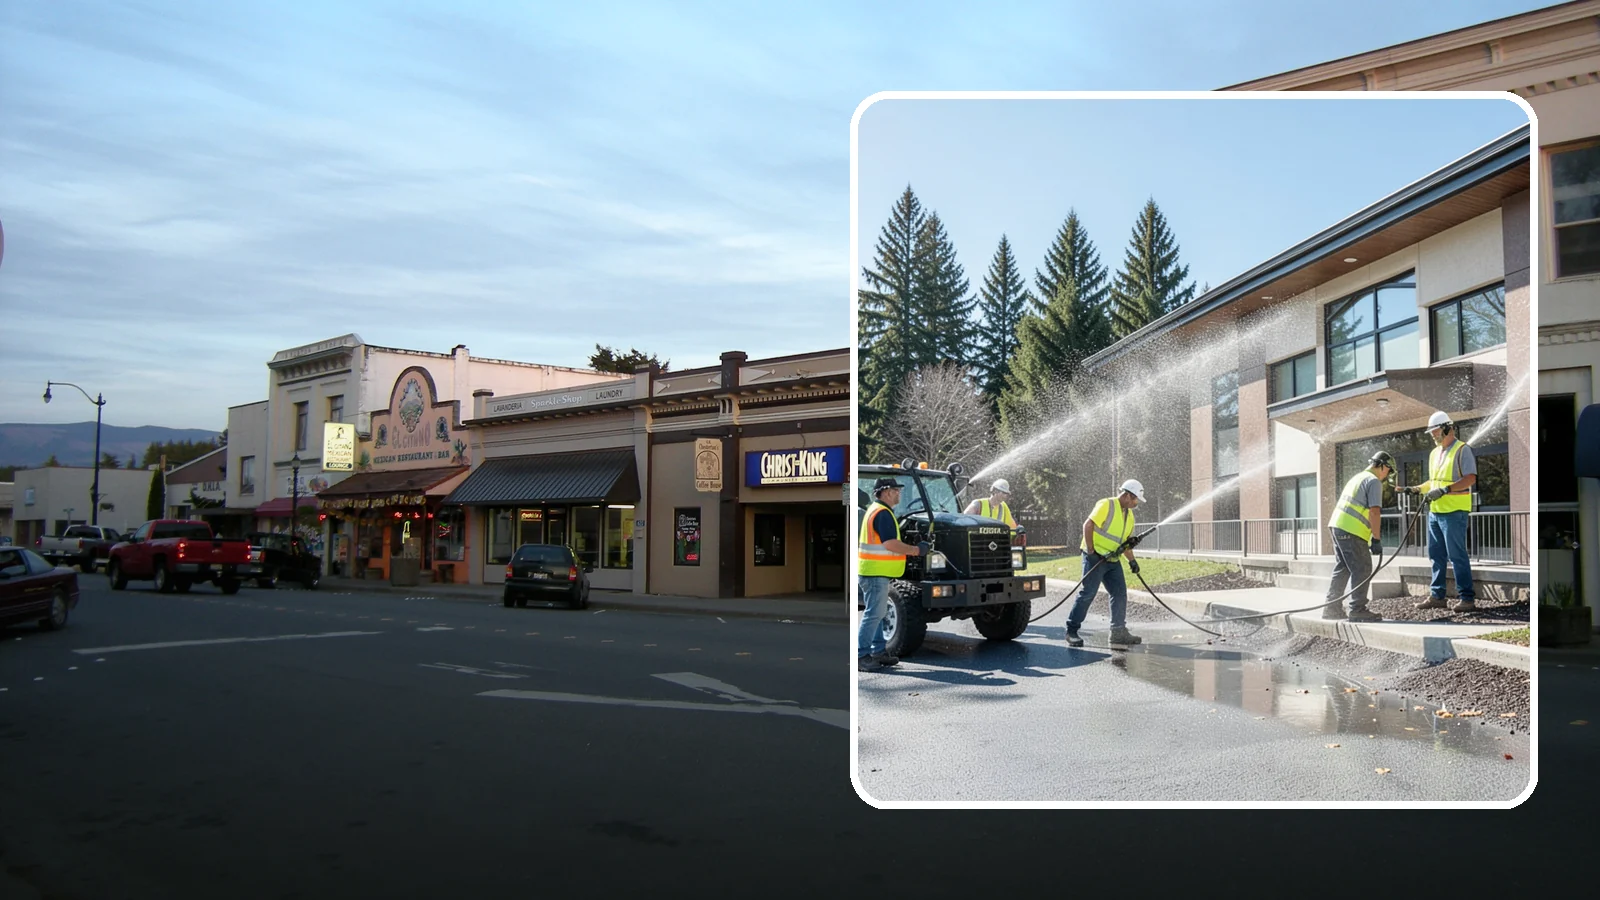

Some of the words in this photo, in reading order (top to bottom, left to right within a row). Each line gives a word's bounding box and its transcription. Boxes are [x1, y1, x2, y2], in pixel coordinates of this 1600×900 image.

[595, 389, 623, 400] LAUNDRY
[493, 402, 522, 413] LAVANDERIA
[531, 399, 561, 408] Sparkle
[562, 395, 582, 405] Shop
[373, 456, 395, 464] MEXICAN
[397, 452, 433, 462] RESTAURANT
[437, 450, 450, 459] BAR
[760, 452, 797, 478] CHRIST
[799, 450, 827, 476] KING
[696, 480, 709, 489] Coffee
[710, 480, 722, 489] House
